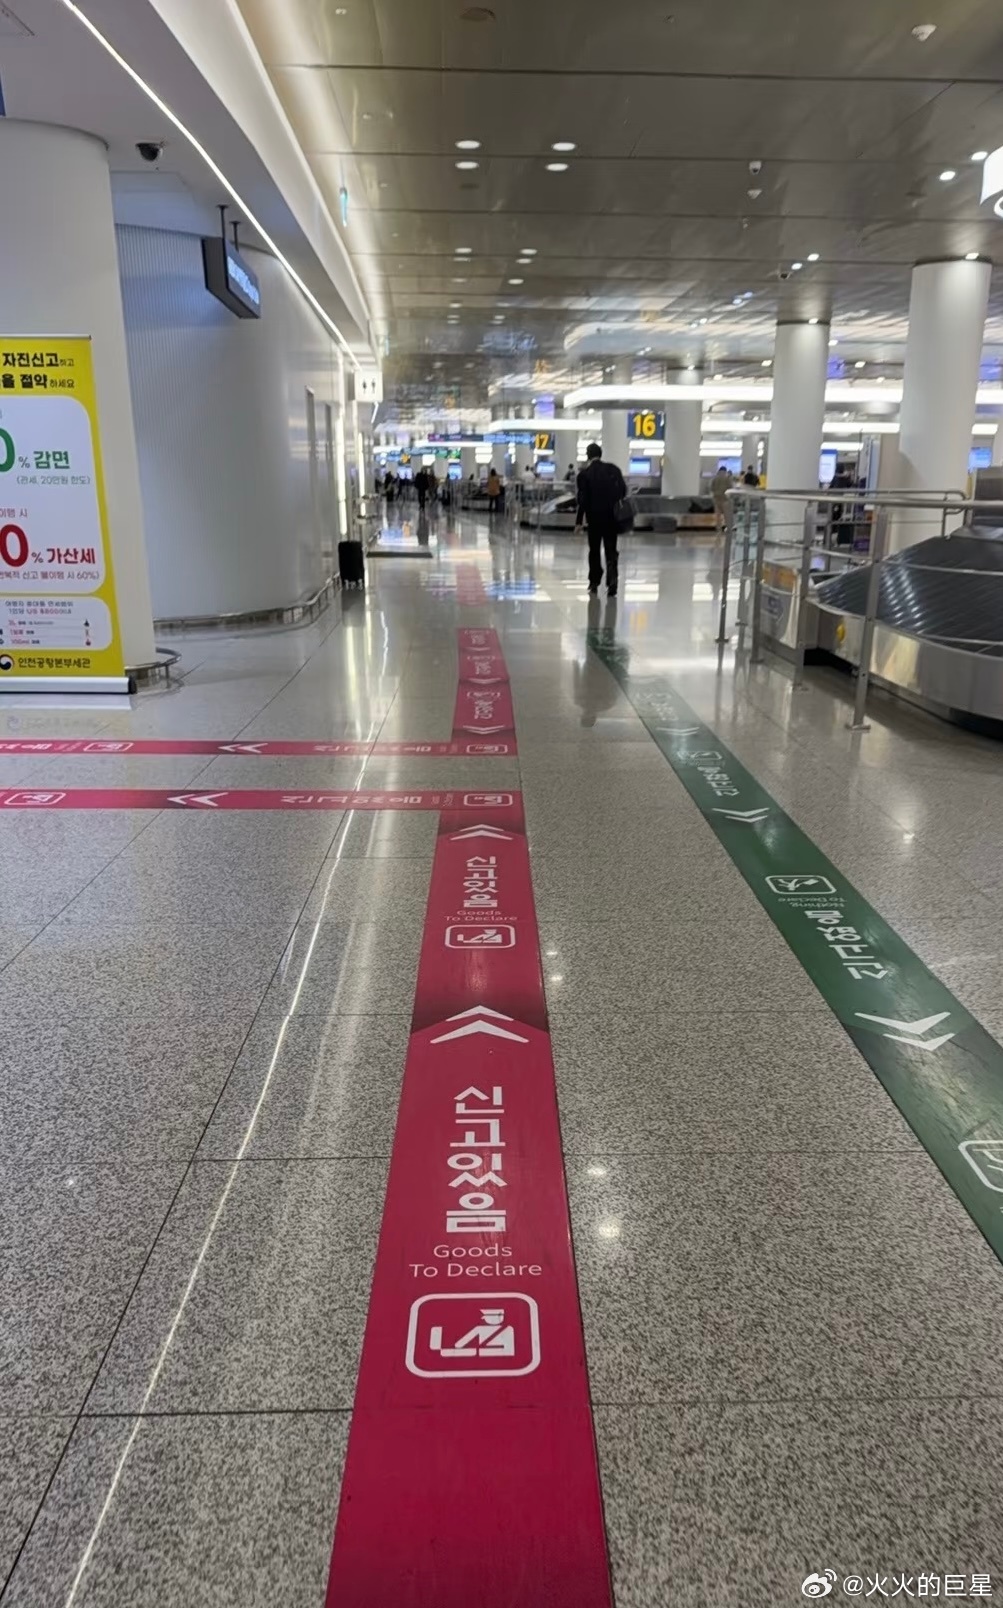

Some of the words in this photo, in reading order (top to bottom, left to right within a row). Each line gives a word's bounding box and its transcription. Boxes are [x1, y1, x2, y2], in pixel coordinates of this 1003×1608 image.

[633, 414, 656, 437] 16
[535, 434, 549, 449] 17
[33, 451, 70, 469] 감면
[46, 548, 96, 564] 가산세
[23, 571, 38, 579] 신고
[18, 657, 91, 668] 인천공항본부세관
[463, 856, 498, 907] 신고있음
[804, 911, 888, 979] 신고없음
[446, 1086, 508, 1233] 신고있음
[433, 1243, 513, 1258] Goods
[409, 1264, 438, 1278] To
[447, 1262, 542, 1277] Declare
